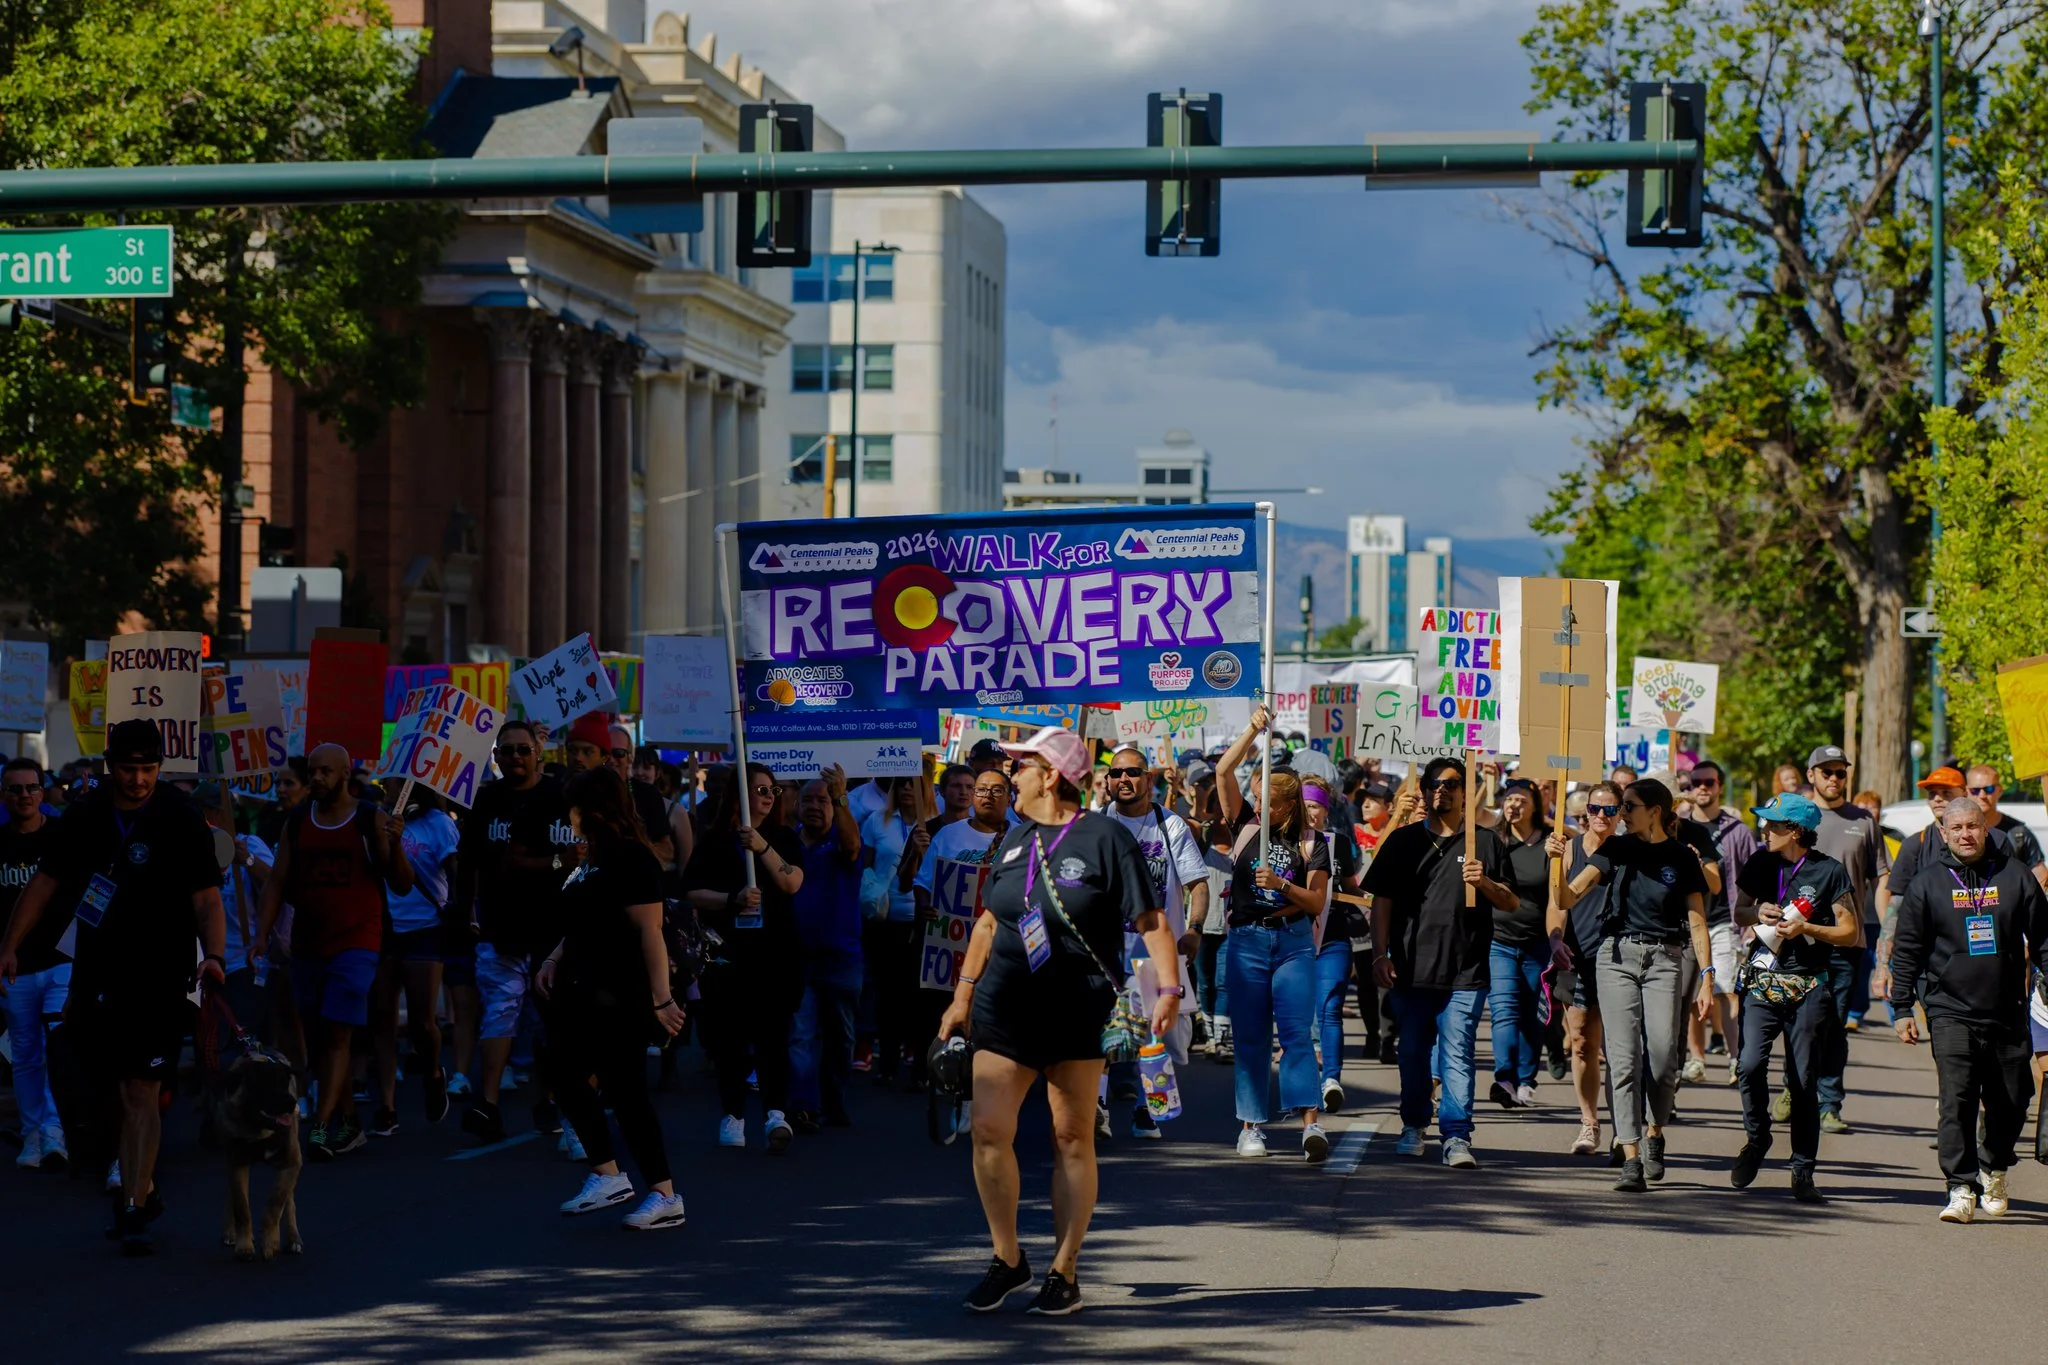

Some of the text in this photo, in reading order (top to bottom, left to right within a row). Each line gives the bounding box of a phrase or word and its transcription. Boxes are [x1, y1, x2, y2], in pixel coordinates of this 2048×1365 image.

[126, 238, 144, 256] St
[105, 267, 163, 285] 300 E
[885, 529, 1113, 572] 2026 WALK FOR
[1156, 532, 1239, 544] Centennial Peaks
[1159, 544, 1237, 553] HOSPITAL
[790, 546, 873, 558] Centennial Peaks
[793, 558, 872, 567] HOSPITAL
[771, 565, 1232, 660] RECOVERY
[1421, 608, 1501, 635] ADDICTI
[110, 648, 201, 673] RECOVERY
[886, 638, 1121, 693] PARADE
[1437, 636, 1501, 671] FREE
[765, 665, 844, 682] ADVOCATES
[1151, 669, 1192, 679] PURPOSE
[1437, 671, 1492, 698] AND
[1643, 672, 1706, 699] growing
[131, 686, 164, 707] IS
[201, 676, 247, 716] PE
[797, 683, 844, 697] RECOVERY
[1311, 684, 1359, 704] RECOVERY
[402, 685, 494, 734] BREAKING
[1375, 690, 1417, 721] Gr
[415, 710, 456, 740] THE
[770, 725, 780, 733] W.
[781, 724, 806, 732] Colfax
[841, 723, 857, 731] 101D
[862, 722, 917, 730] 720-685-6250
[1121, 719, 1157, 737] STAY
[1325, 708, 1343, 733] IS
[1358, 723, 1386, 751] In
[1444, 721, 1483, 747] ME
[199, 726, 287, 774] PPENS
[751, 749, 814, 762] Same Day
[376, 732, 476, 806] STIGMA
[768, 761, 820, 773] dication
[866, 759, 919, 769] Community
[933, 859, 991, 918] KEE
[1956, 889, 1995, 898] Dikes
[927, 915, 977, 942] MOV
[922, 945, 966, 986] FOR
